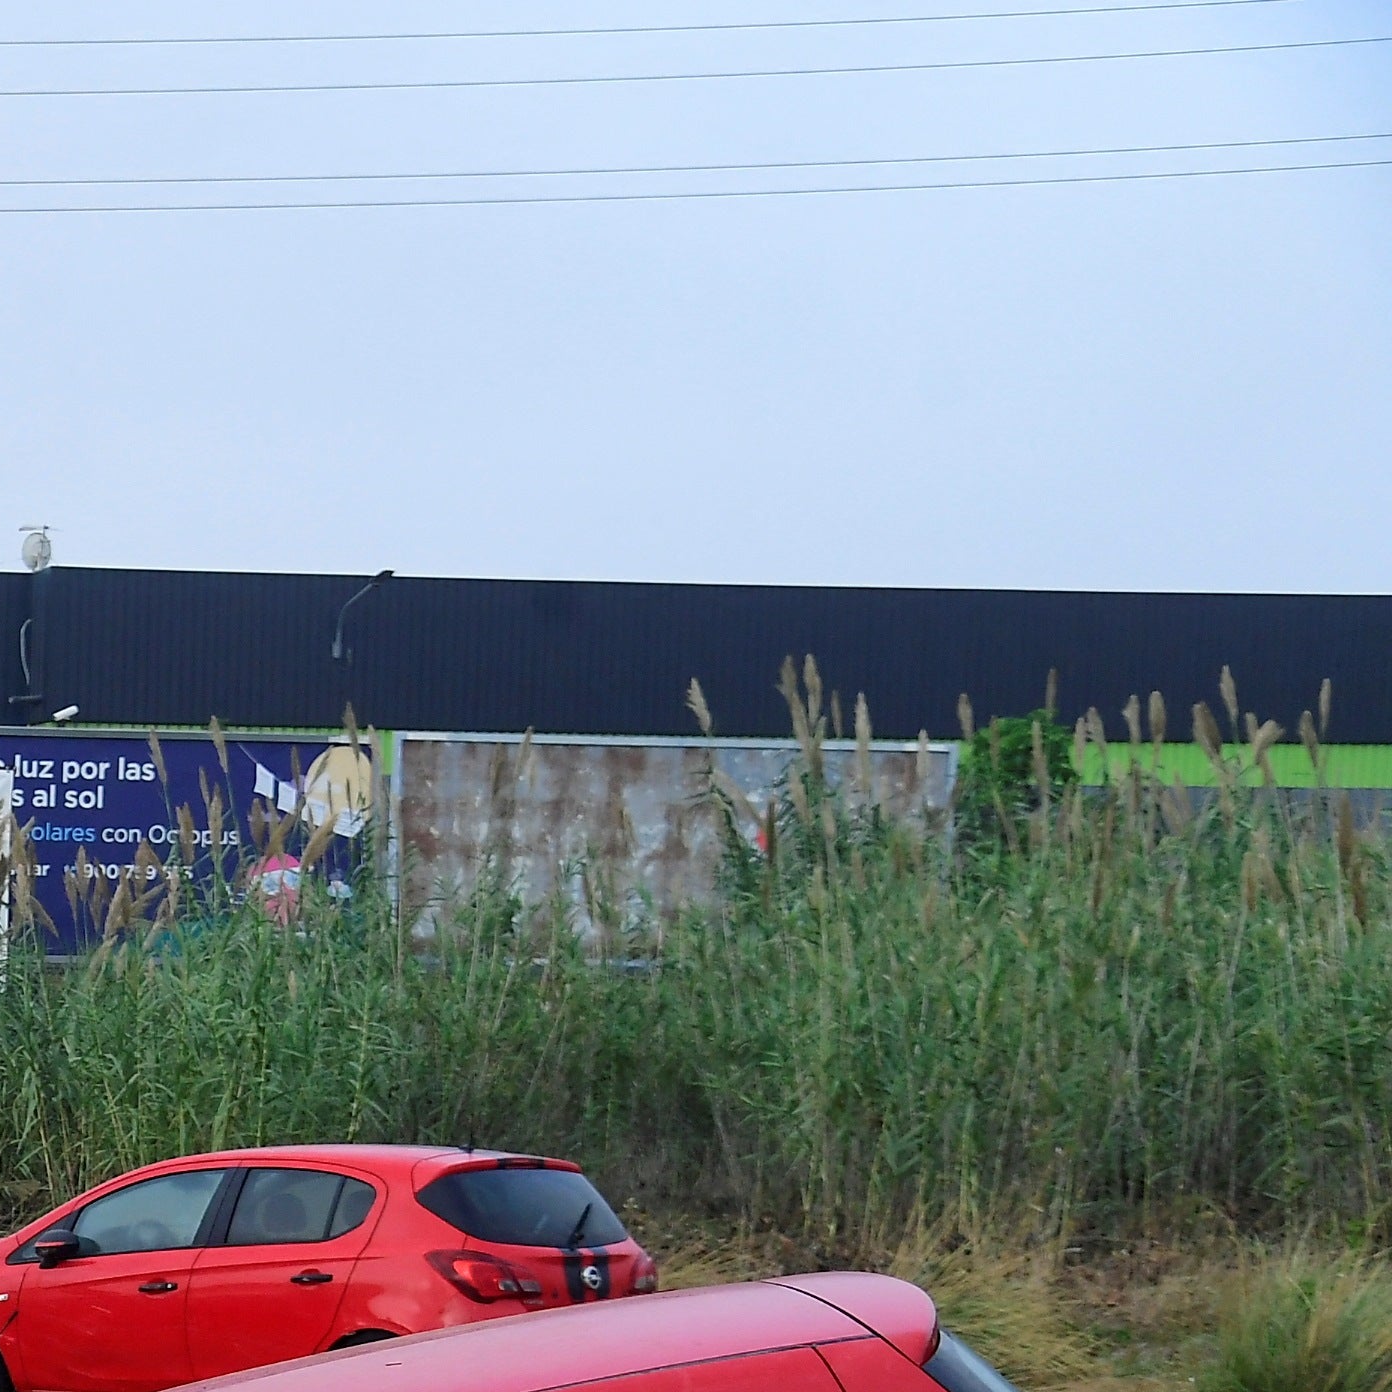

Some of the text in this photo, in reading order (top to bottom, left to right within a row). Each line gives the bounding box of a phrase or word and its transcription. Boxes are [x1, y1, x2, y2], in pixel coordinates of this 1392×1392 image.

[15, 754, 54, 778] luz
[62, 761, 110, 783] por
[118, 757, 156, 781] las
[32, 784, 56, 807] al
[64, 785, 103, 809] sol
[102, 828, 142, 843] con
[148, 824, 239, 848] Ocopus
